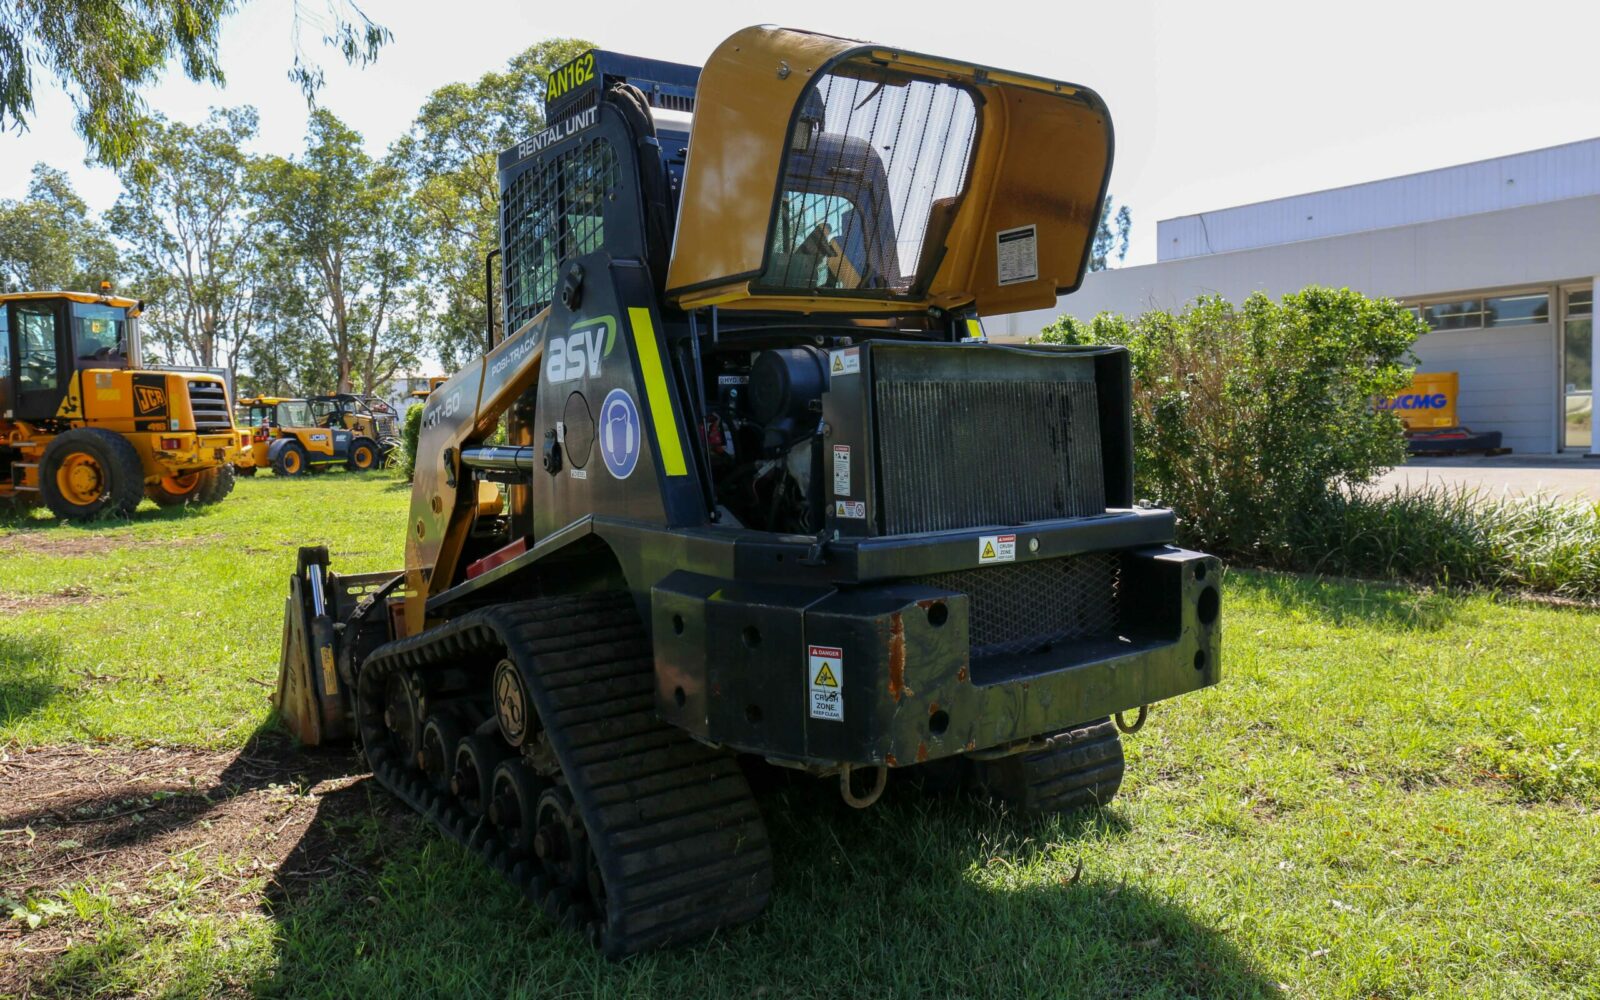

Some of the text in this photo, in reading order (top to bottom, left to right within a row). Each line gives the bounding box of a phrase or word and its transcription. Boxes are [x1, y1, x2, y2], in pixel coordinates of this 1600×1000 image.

[547, 53, 594, 102] AN162
[518, 106, 597, 160] RENTAL UNIT
[139, 388, 164, 411] JCB
[818, 649, 838, 657] DANGER
[816, 702, 836, 711] ZONE
